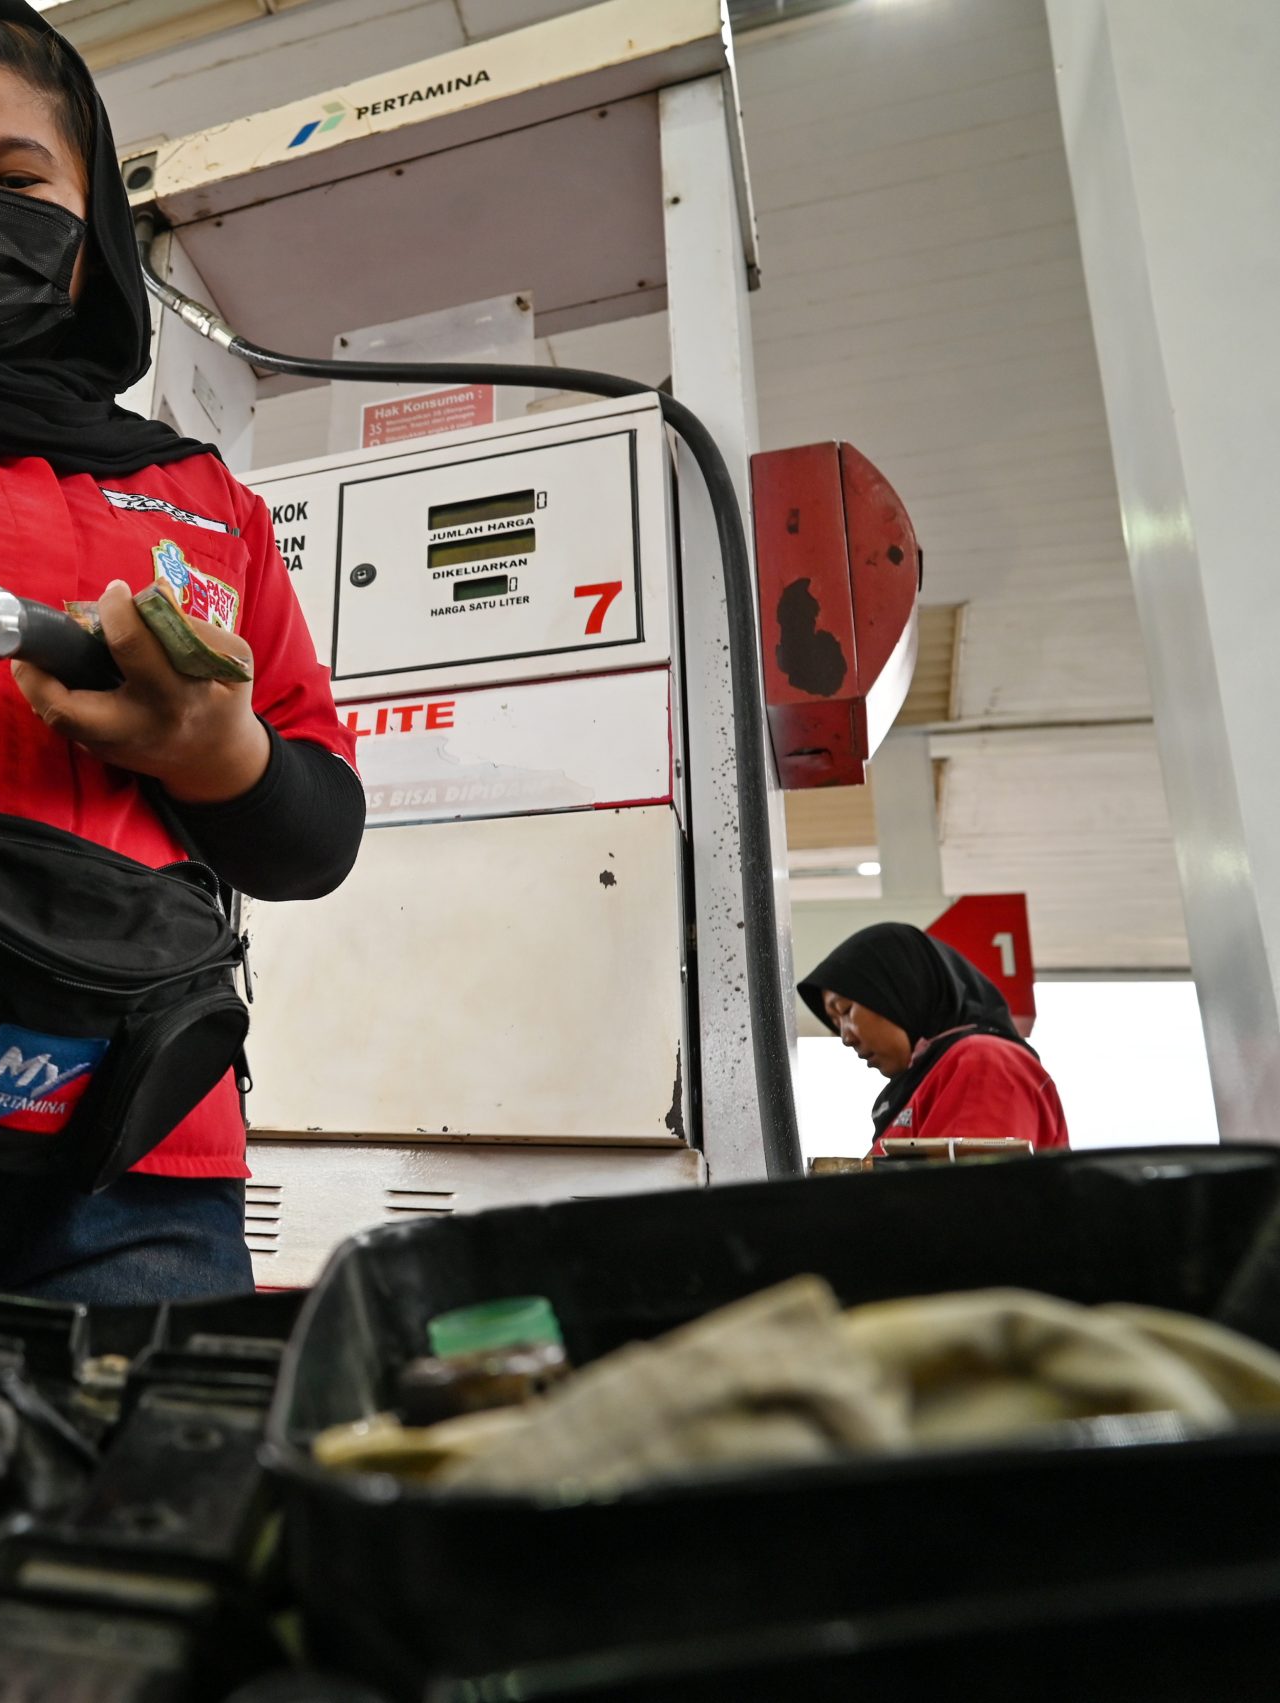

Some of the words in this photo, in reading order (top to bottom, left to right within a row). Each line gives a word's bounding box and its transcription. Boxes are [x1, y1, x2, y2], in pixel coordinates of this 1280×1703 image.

[355, 70, 490, 120] PERTAMINA
[375, 406, 399, 419] Hak
[403, 391, 474, 413] Konsumen
[267, 501, 308, 525] KOK
[429, 526, 483, 542] JUMLAH
[487, 517, 535, 532] HARGA
[432, 558, 528, 580] DIKELUARKAN
[430, 604, 466, 616] HARGA
[469, 600, 496, 612] SATU
[499, 596, 530, 608] LITER
[574, 581, 622, 635] 7
[346, 701, 456, 737] LITE
[389, 788, 437, 806] BISA
[991, 932, 1016, 976] 1
